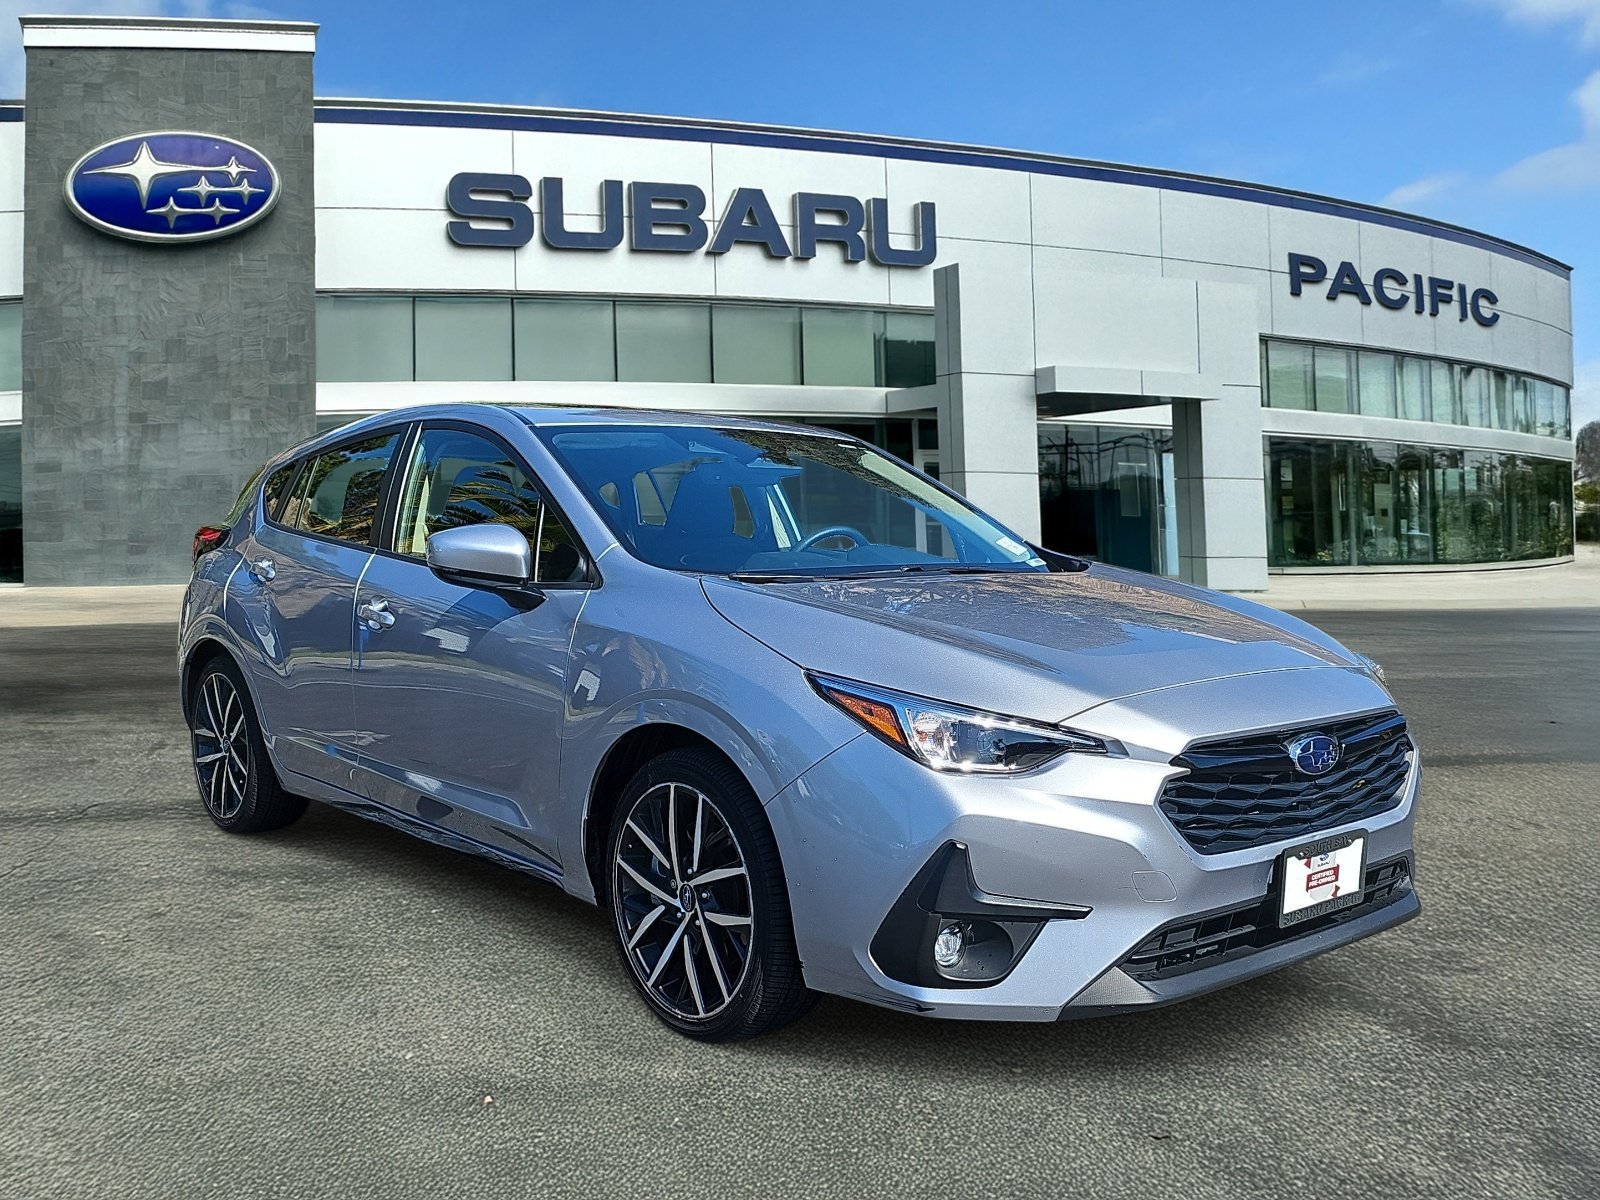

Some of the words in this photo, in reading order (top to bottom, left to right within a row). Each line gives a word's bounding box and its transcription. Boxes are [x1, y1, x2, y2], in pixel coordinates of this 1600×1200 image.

[446, 171, 937, 268] SUBARU
[1287, 252, 1501, 327] PACIFIC
[1304, 839, 1333, 856] SOUTH
[1308, 875, 1336, 888] PRE-OWNED
[1311, 869, 1334, 881] CERTIFIED
